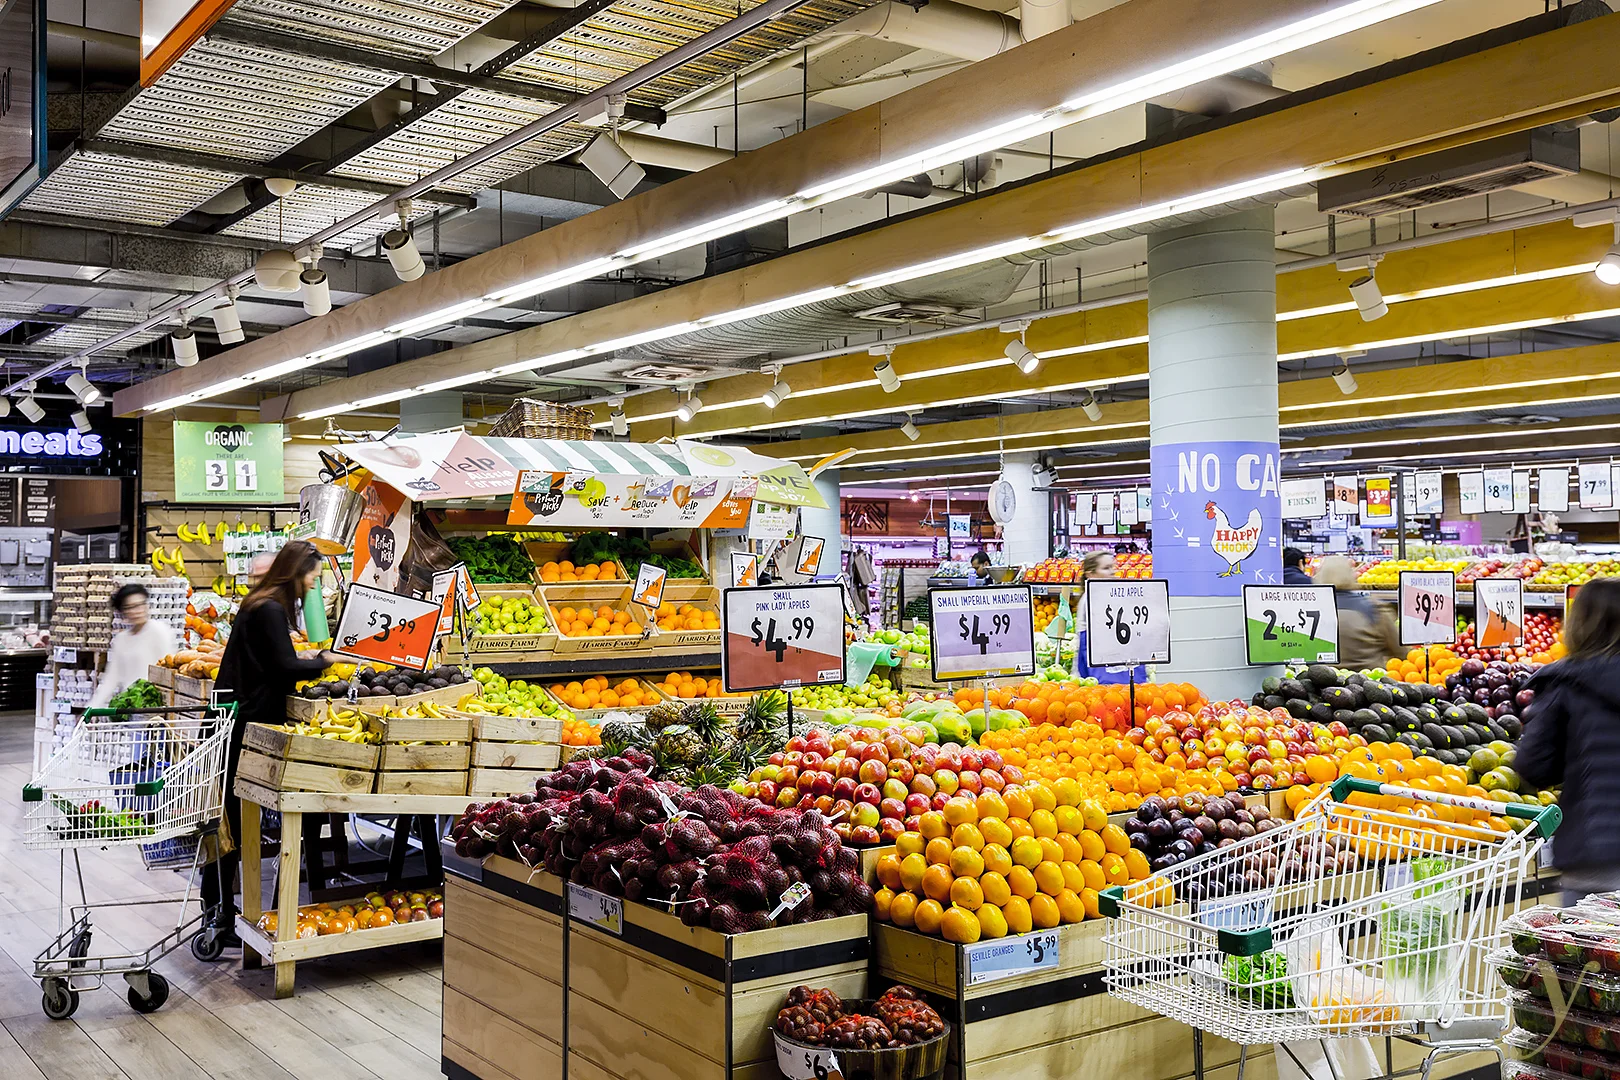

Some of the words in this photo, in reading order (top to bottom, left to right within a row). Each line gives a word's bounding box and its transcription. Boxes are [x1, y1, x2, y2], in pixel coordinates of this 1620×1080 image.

[205, 430, 253, 446] ORGANIC
[432, 457, 496, 474] Help
[1178, 451, 1221, 493] NO
[1236, 453, 1281, 498] CA
[1419, 487, 1438, 500] $9.99
[1488, 484, 1509, 498] $8.99
[1584, 480, 1607, 494] $7.99
[1288, 496, 1317, 506] FINEST!
[1216, 527, 1259, 542] HAPPY
[355, 590, 372, 600] Wonky
[372, 594, 396, 605] Bananas
[773, 591, 792, 601] SMALL
[1110, 587, 1125, 598] JAZZ
[1127, 586, 1144, 597] APPLE
[1260, 591, 1280, 601] LARGE
[1283, 591, 1317, 602] AVOCADOS
[756, 602, 769, 612] PINK
[771, 601, 786, 611] LADY
[788, 600, 811, 610] APPLES
[937, 596, 959, 608] SMALL
[961, 595, 990, 606] IMPERIAL
[992, 593, 1029, 605] MANDARINS
[1415, 592, 1444, 627] $9.99
[367, 609, 416, 643] $3.99
[1105, 604, 1149, 645] $6.99
[1262, 609, 1278, 640] 2
[1281, 622, 1295, 633] for
[1298, 608, 1321, 641] $7
[678, 635, 706, 643] HARRIS
[706, 634, 721, 642] FAR
[751, 616, 815, 663] $4.99
[959, 613, 1011, 655] $4.99
[476, 639, 509, 648] HARRIS
[510, 639, 535, 648] FARM
[582, 641, 613, 649] HARRIS
[613, 640, 636, 648] FARM
[143, 842, 160, 851] NEW
[145, 847, 173, 860] FARMERS
[600, 897, 618, 922] $4.99
[971, 949, 991, 962] SEVILLE
[992, 944, 1015, 958] ORANGES
[1026, 935, 1056, 964] $5.99
